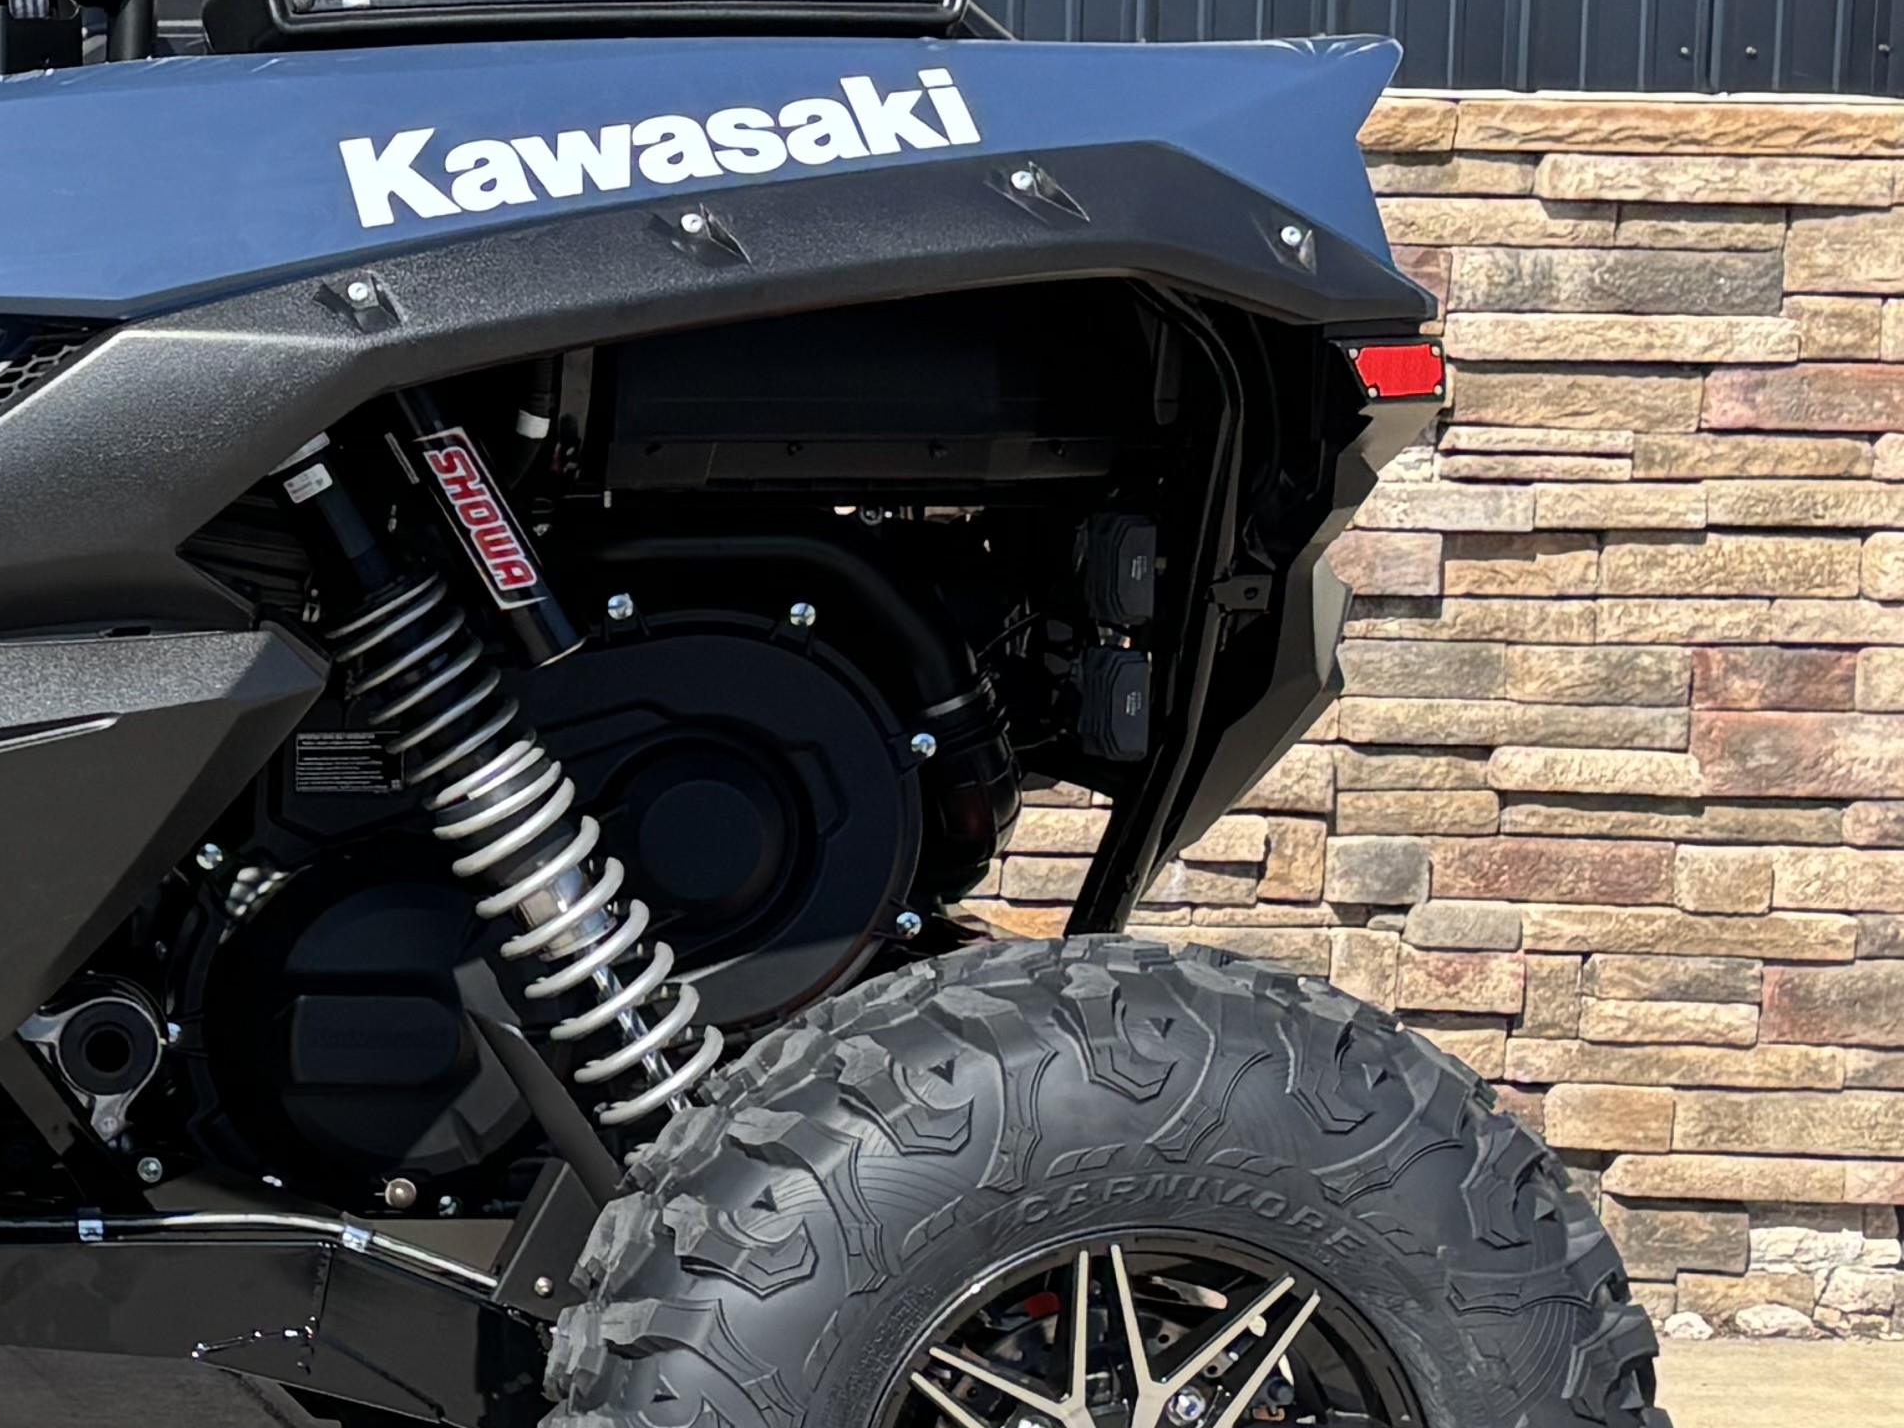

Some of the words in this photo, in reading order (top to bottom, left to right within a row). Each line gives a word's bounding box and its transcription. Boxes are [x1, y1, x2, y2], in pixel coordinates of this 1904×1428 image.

[338, 67, 982, 228] Kawasaki
[423, 446, 537, 591] SHOWA
[1019, 1172, 1368, 1256] CARNIVORE
